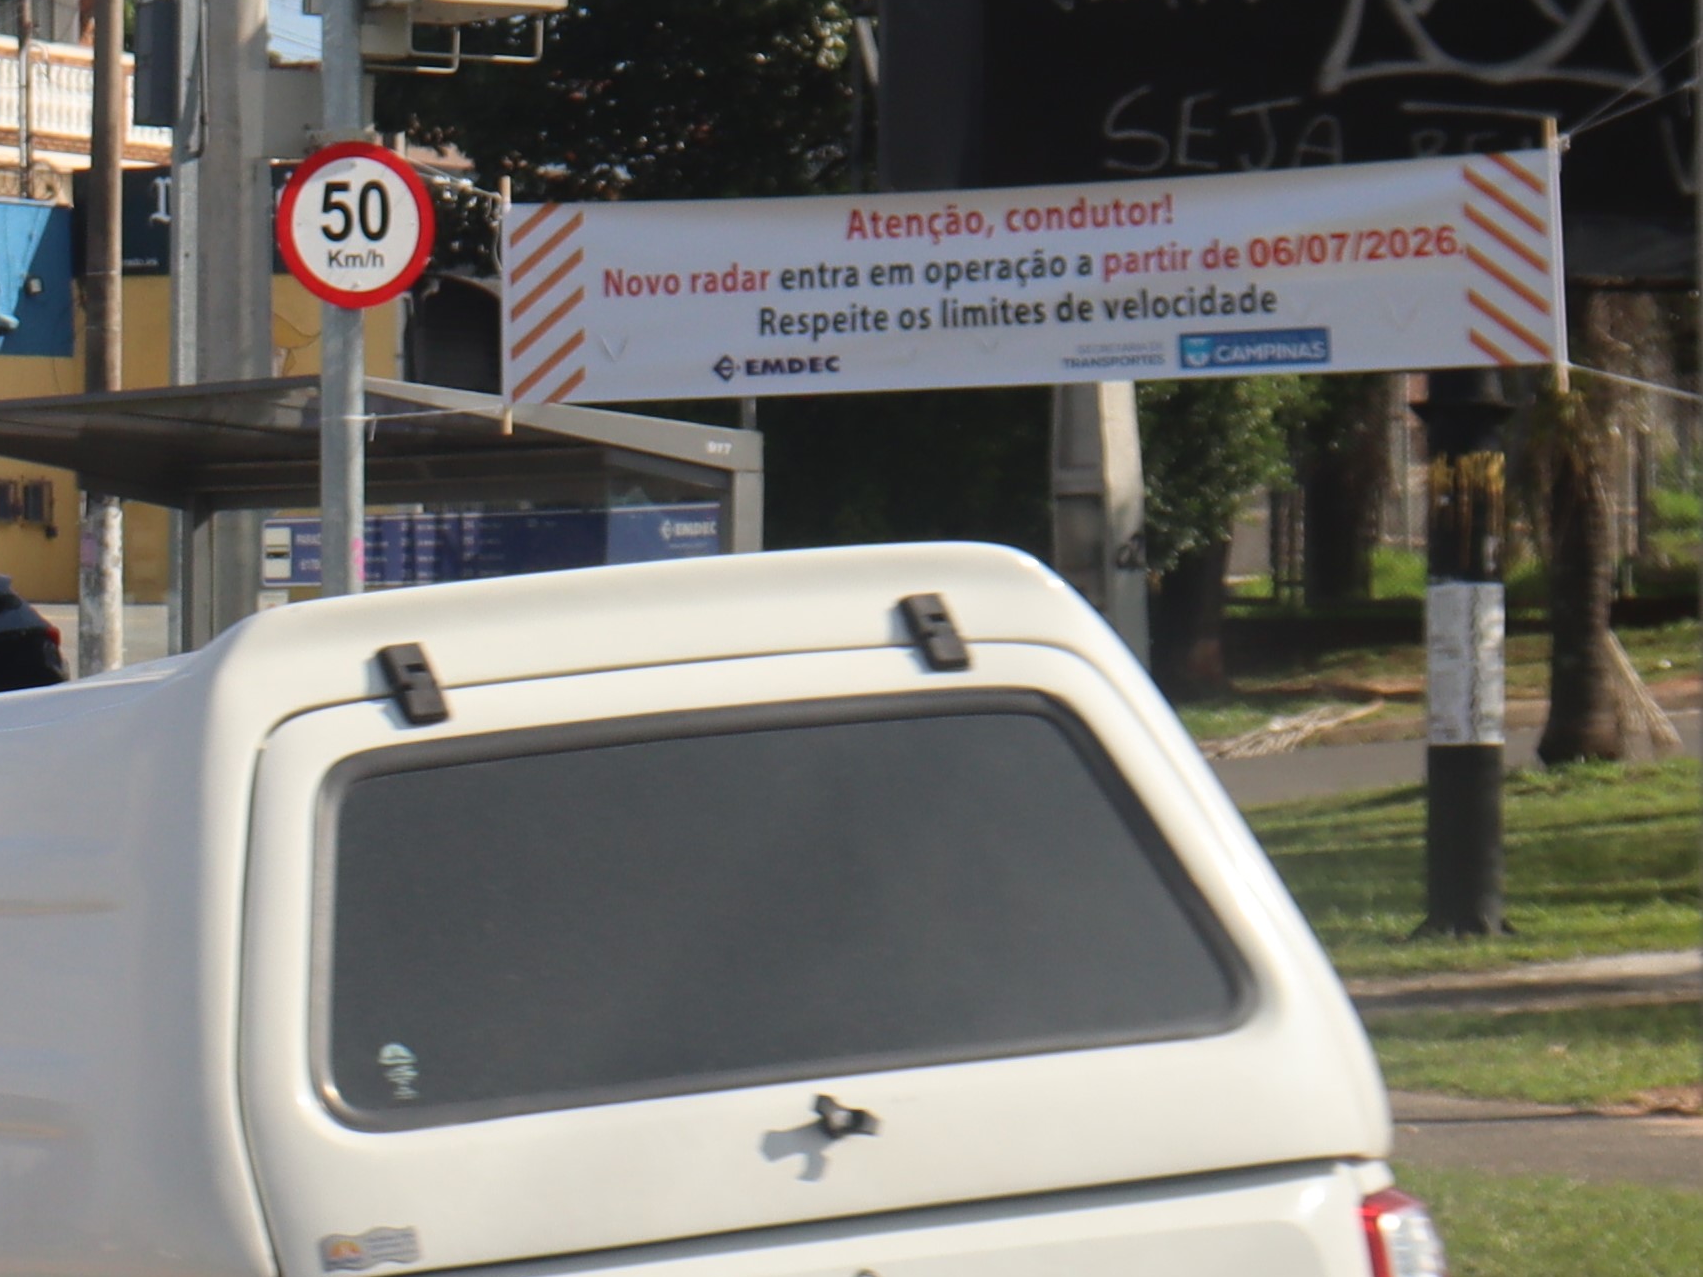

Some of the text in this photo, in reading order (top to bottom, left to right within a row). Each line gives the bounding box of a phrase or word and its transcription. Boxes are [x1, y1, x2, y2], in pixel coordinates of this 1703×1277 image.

[1103, 86, 1345, 172] SEJA
[320, 179, 390, 242] 50
[846, 193, 1175, 243] Atenção, condutor!
[327, 249, 385, 268] Km/h
[604, 224, 1465, 299] Novo radar entra em operação a partir de 06/07/2026.
[758, 282, 1278, 342] Respeite os limites de velocidade
[746, 356, 841, 376] EMDEC
[1062, 353, 1166, 368] TRANSPORTES
[1215, 340, 1326, 364] CAMPINAS
